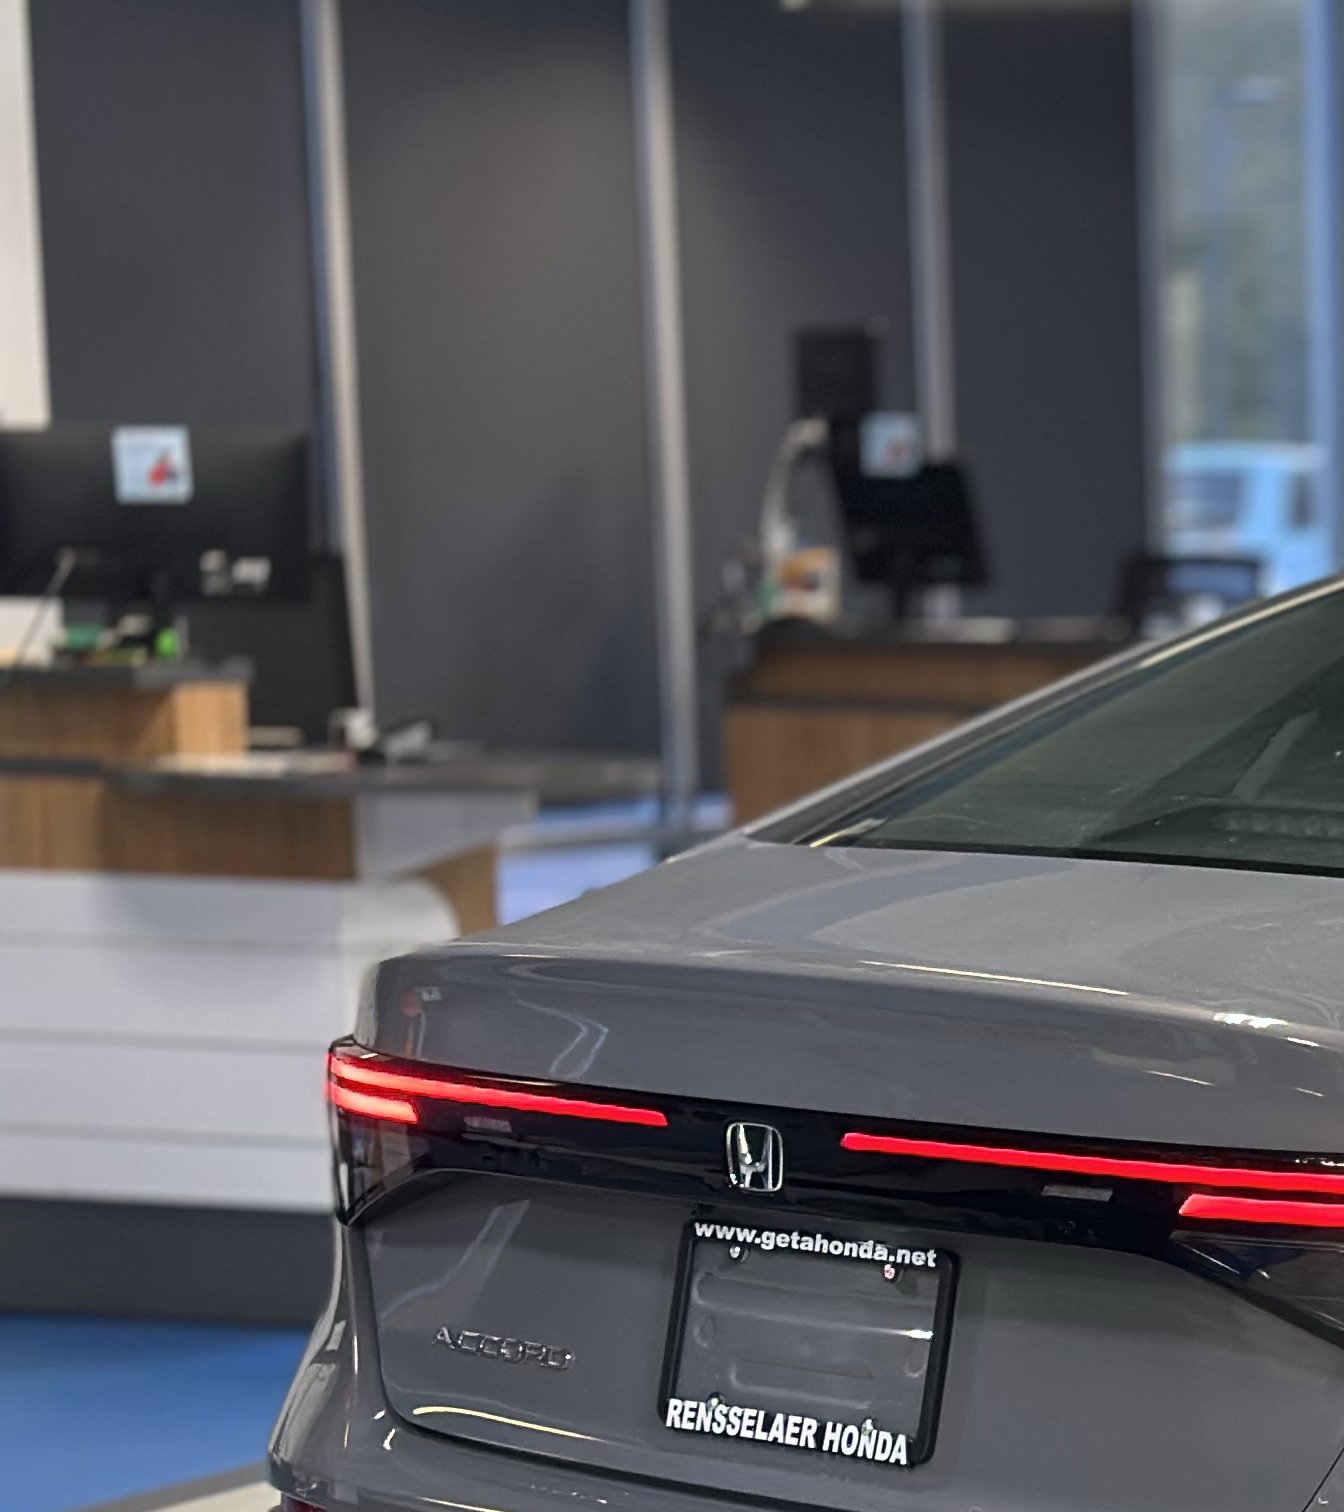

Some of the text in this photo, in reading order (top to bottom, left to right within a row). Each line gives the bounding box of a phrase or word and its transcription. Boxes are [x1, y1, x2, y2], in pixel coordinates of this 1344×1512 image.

[694, 1221, 937, 1268] www.getahonda.net
[432, 1325, 575, 1371] ACCORD
[665, 1397, 908, 1466] RENSSELAER HONDA
